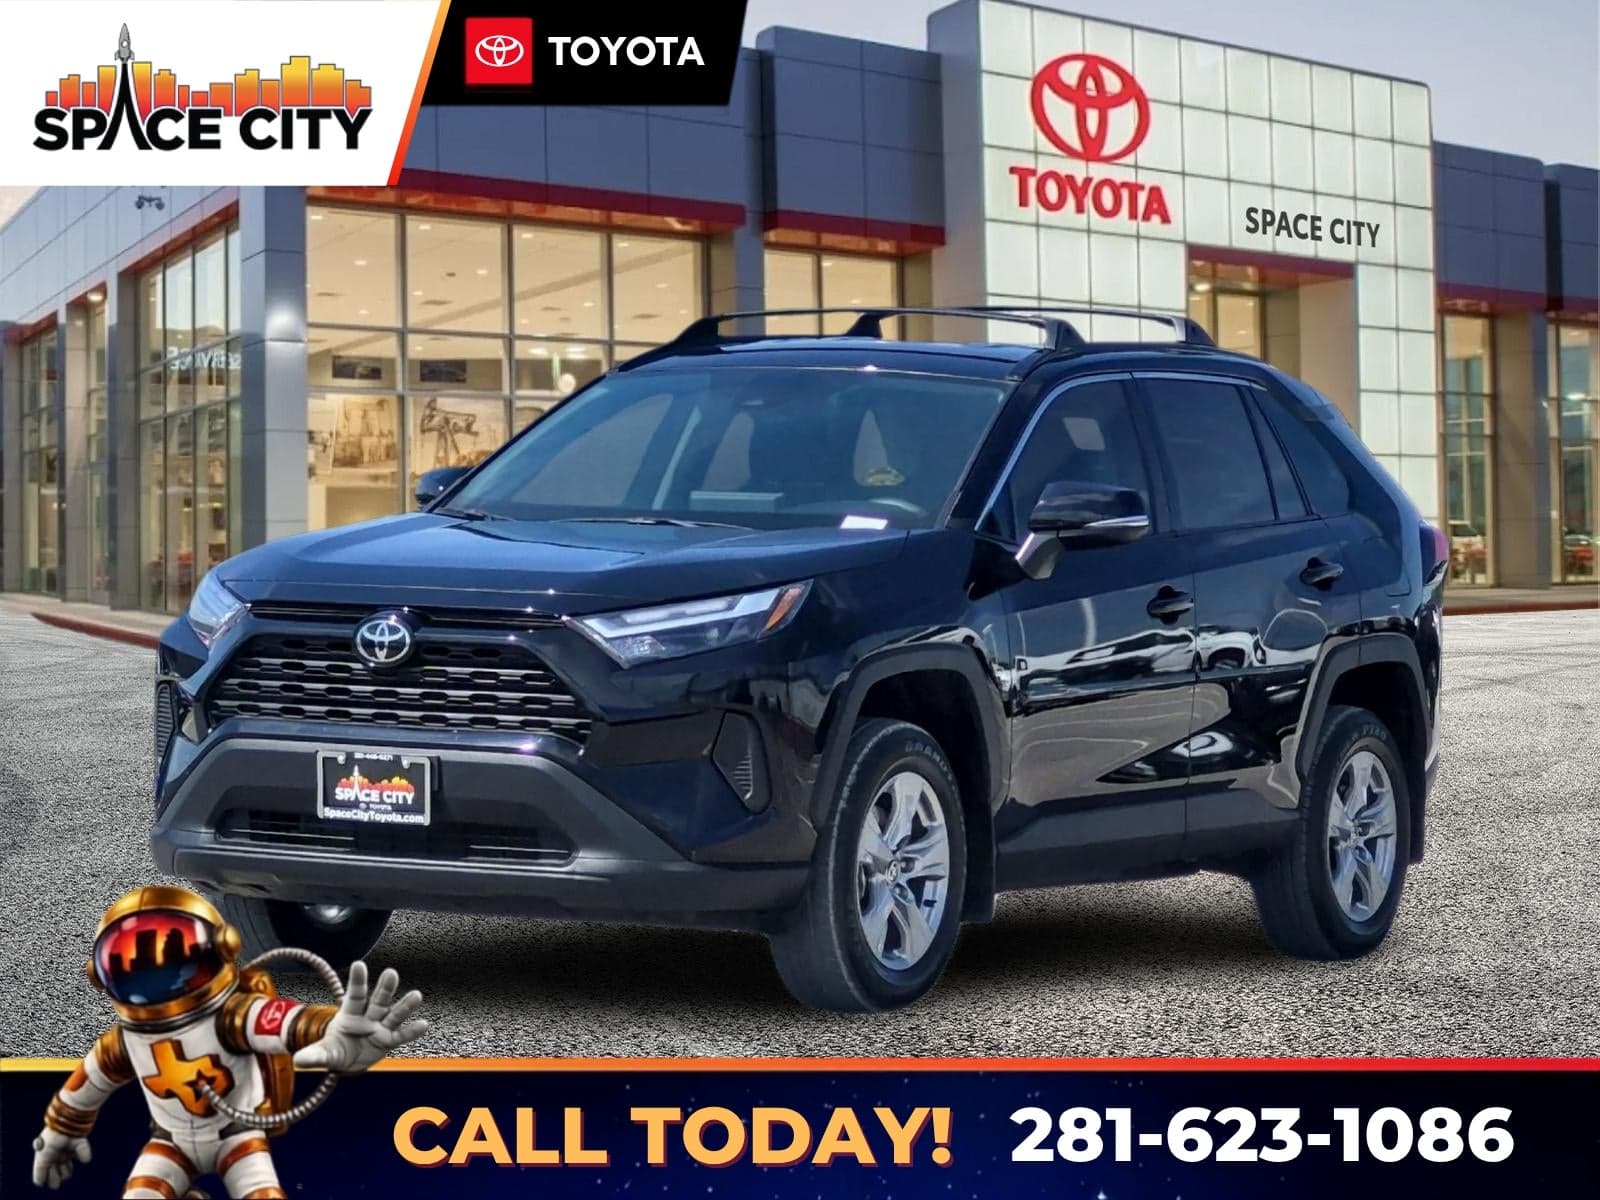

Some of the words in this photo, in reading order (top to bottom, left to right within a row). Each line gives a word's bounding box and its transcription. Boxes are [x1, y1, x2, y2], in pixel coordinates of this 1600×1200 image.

[1009, 166, 1171, 224] TOYOTA
[1245, 206, 1323, 242] SPACE
[1329, 218, 1381, 248] CITY
[335, 786, 380, 802] SPACE
[382, 790, 415, 805] CITY
[324, 806, 424, 824] SpaceCityToyota.com
